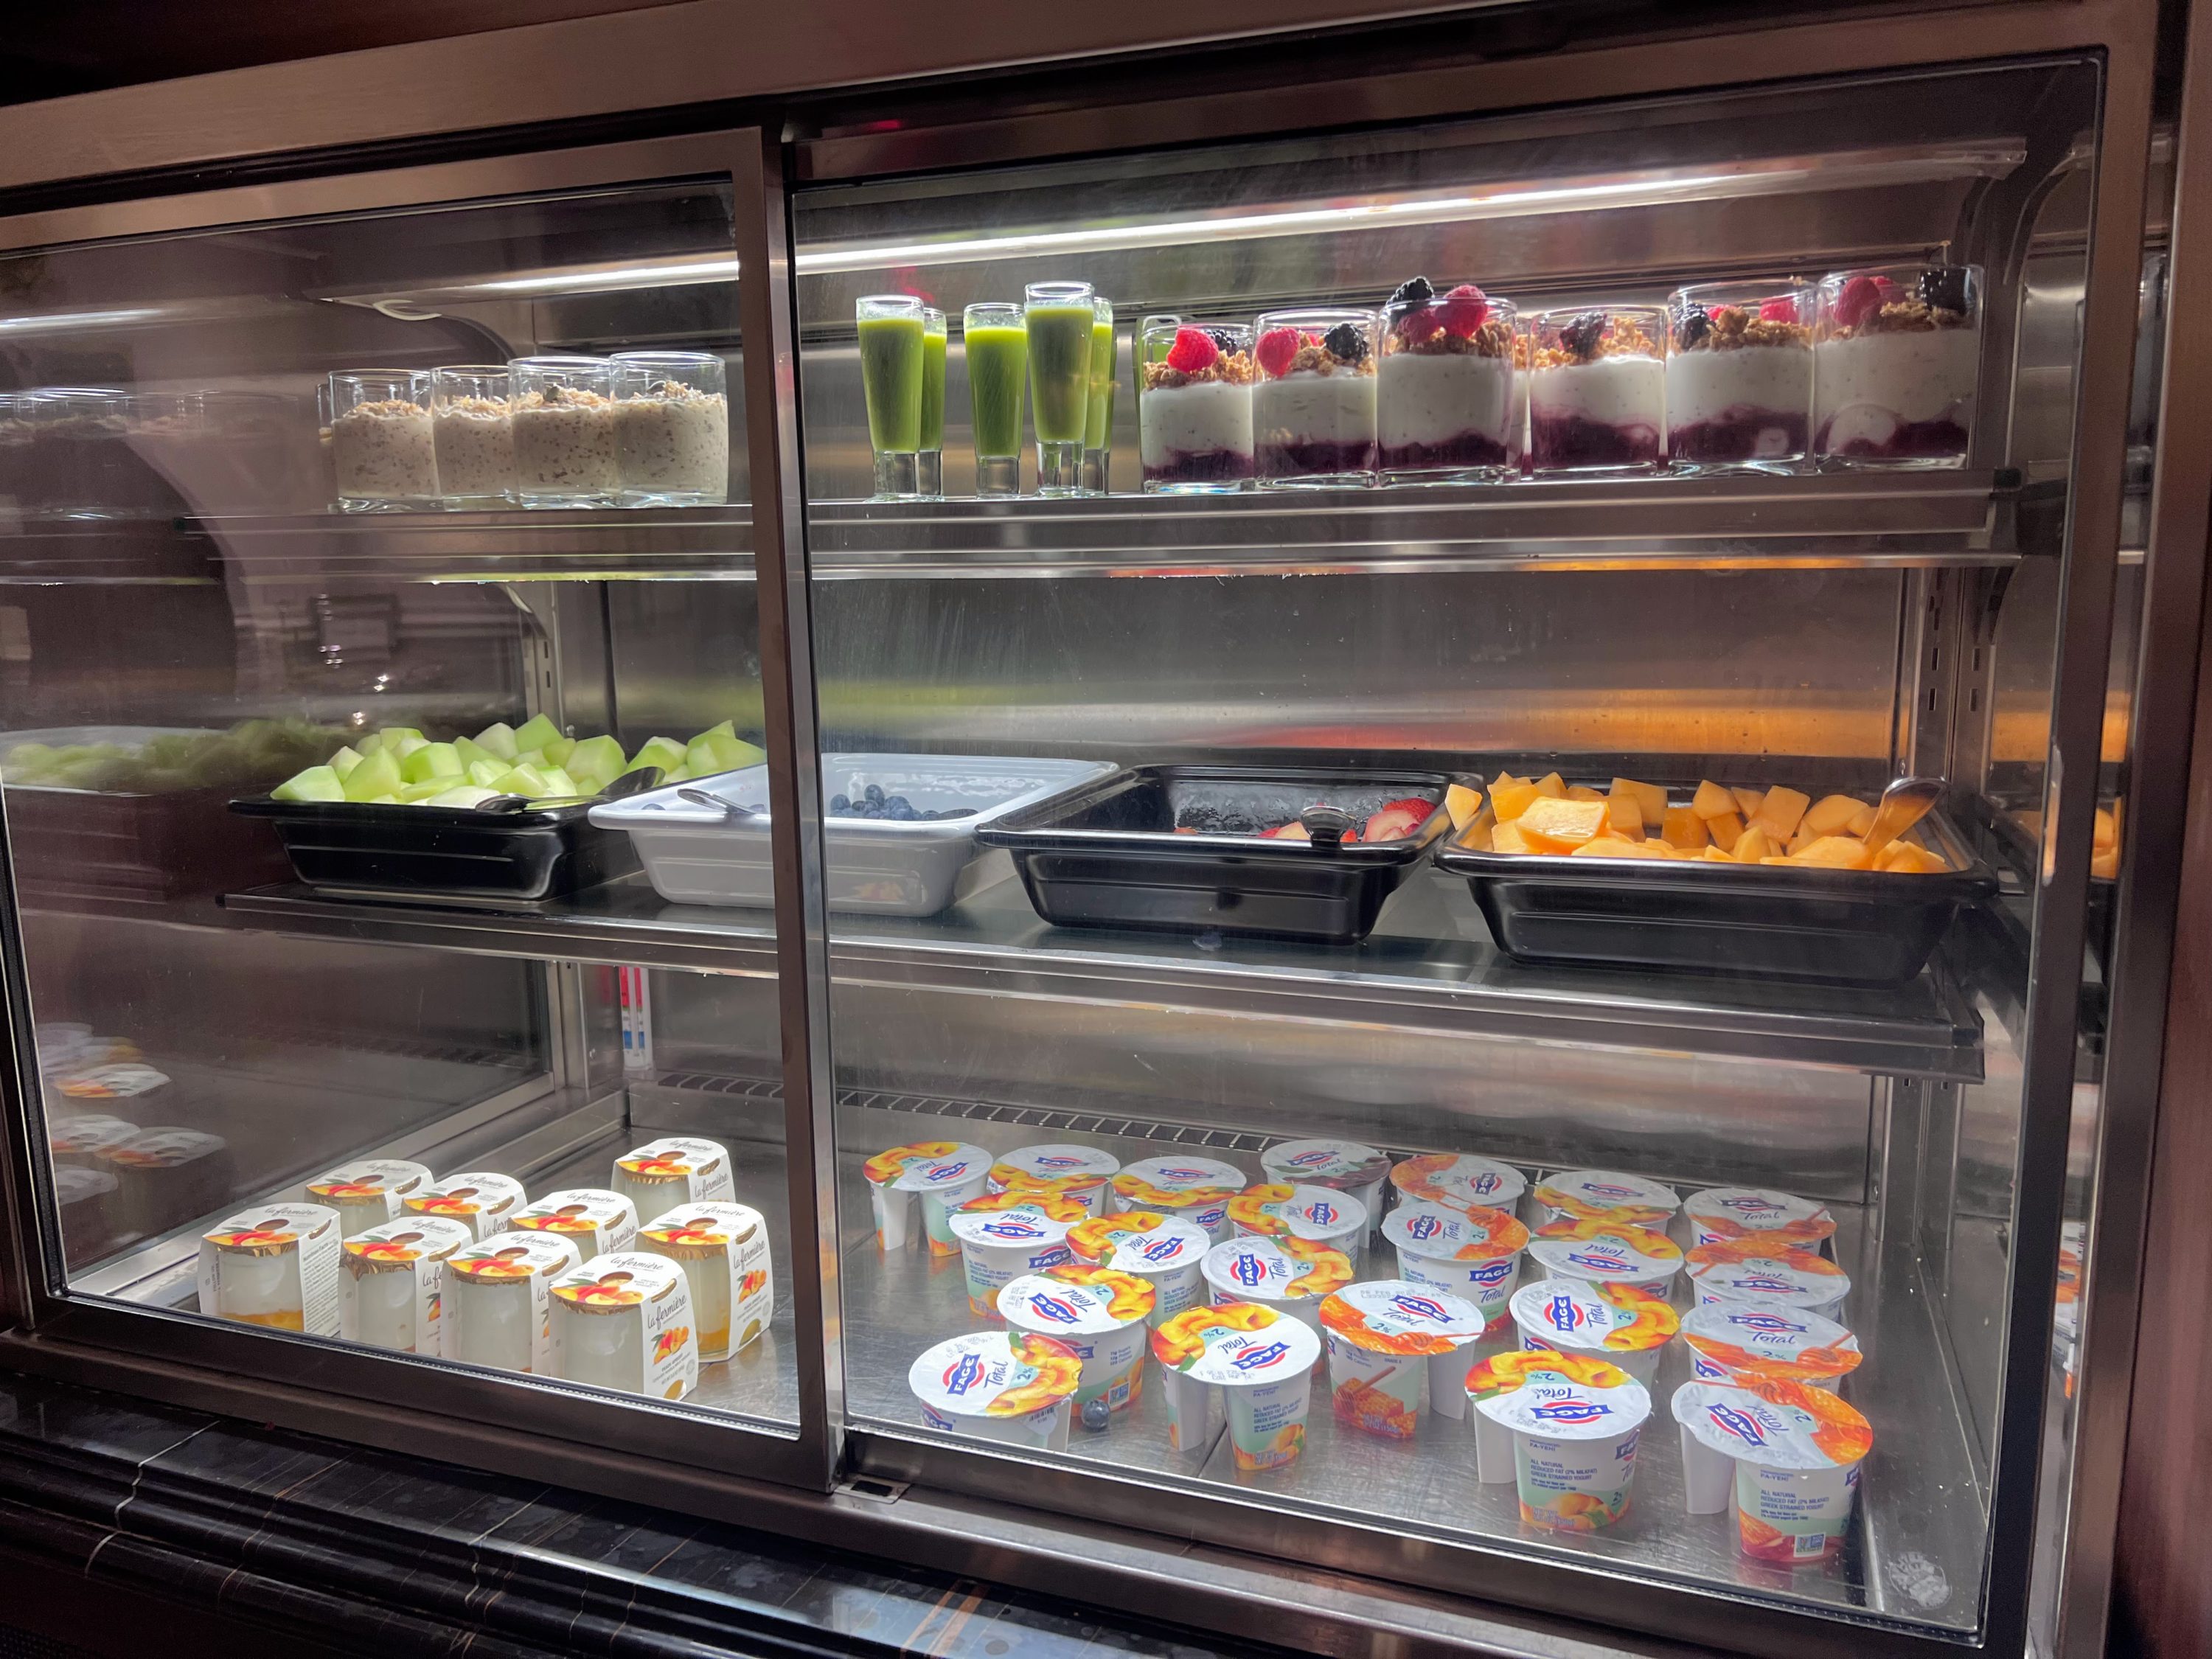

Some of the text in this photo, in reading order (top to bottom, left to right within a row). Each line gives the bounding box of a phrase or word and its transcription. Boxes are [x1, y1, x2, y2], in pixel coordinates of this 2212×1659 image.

[928, 1164, 964, 1180] FAGE
[1000, 1213, 1039, 1225] Total
[1199, 1211, 1224, 1222] FAGE
[1316, 1205, 1325, 1225] FAGE
[987, 1225, 1040, 1238] FAGE
[1416, 1215, 1432, 1238] FAGE
[1443, 1220, 1461, 1240] Total
[1147, 1240, 1179, 1259] FAGE
[1242, 1256, 1255, 1285] FAGE
[1267, 1256, 1289, 1279] Total
[1475, 1265, 1512, 1279] FAGE
[1573, 1255, 1632, 1271] FAGE
[1060, 1288, 1096, 1313] Total
[1478, 1285, 1506, 1304] Total
[655, 1295, 687, 1331] fermière
[1034, 1296, 1076, 1324] FAGE
[1382, 1307, 1425, 1326] Total
[1397, 1298, 1447, 1322] FAGE
[1557, 1298, 1571, 1329] FAGE
[1585, 1302, 1609, 1328] Total
[1372, 1323, 1392, 1334] 2%
[1736, 1317, 1804, 1332] FAGE
[1217, 1336, 1257, 1354] Total
[1745, 1330, 1797, 1345] Total
[1237, 1344, 1283, 1367] FAGE
[953, 1356, 976, 1393] FAGE
[984, 1361, 1009, 1388] Total
[1537, 1405, 1604, 1418] FAGE
[1714, 1405, 1759, 1443] FAGE
